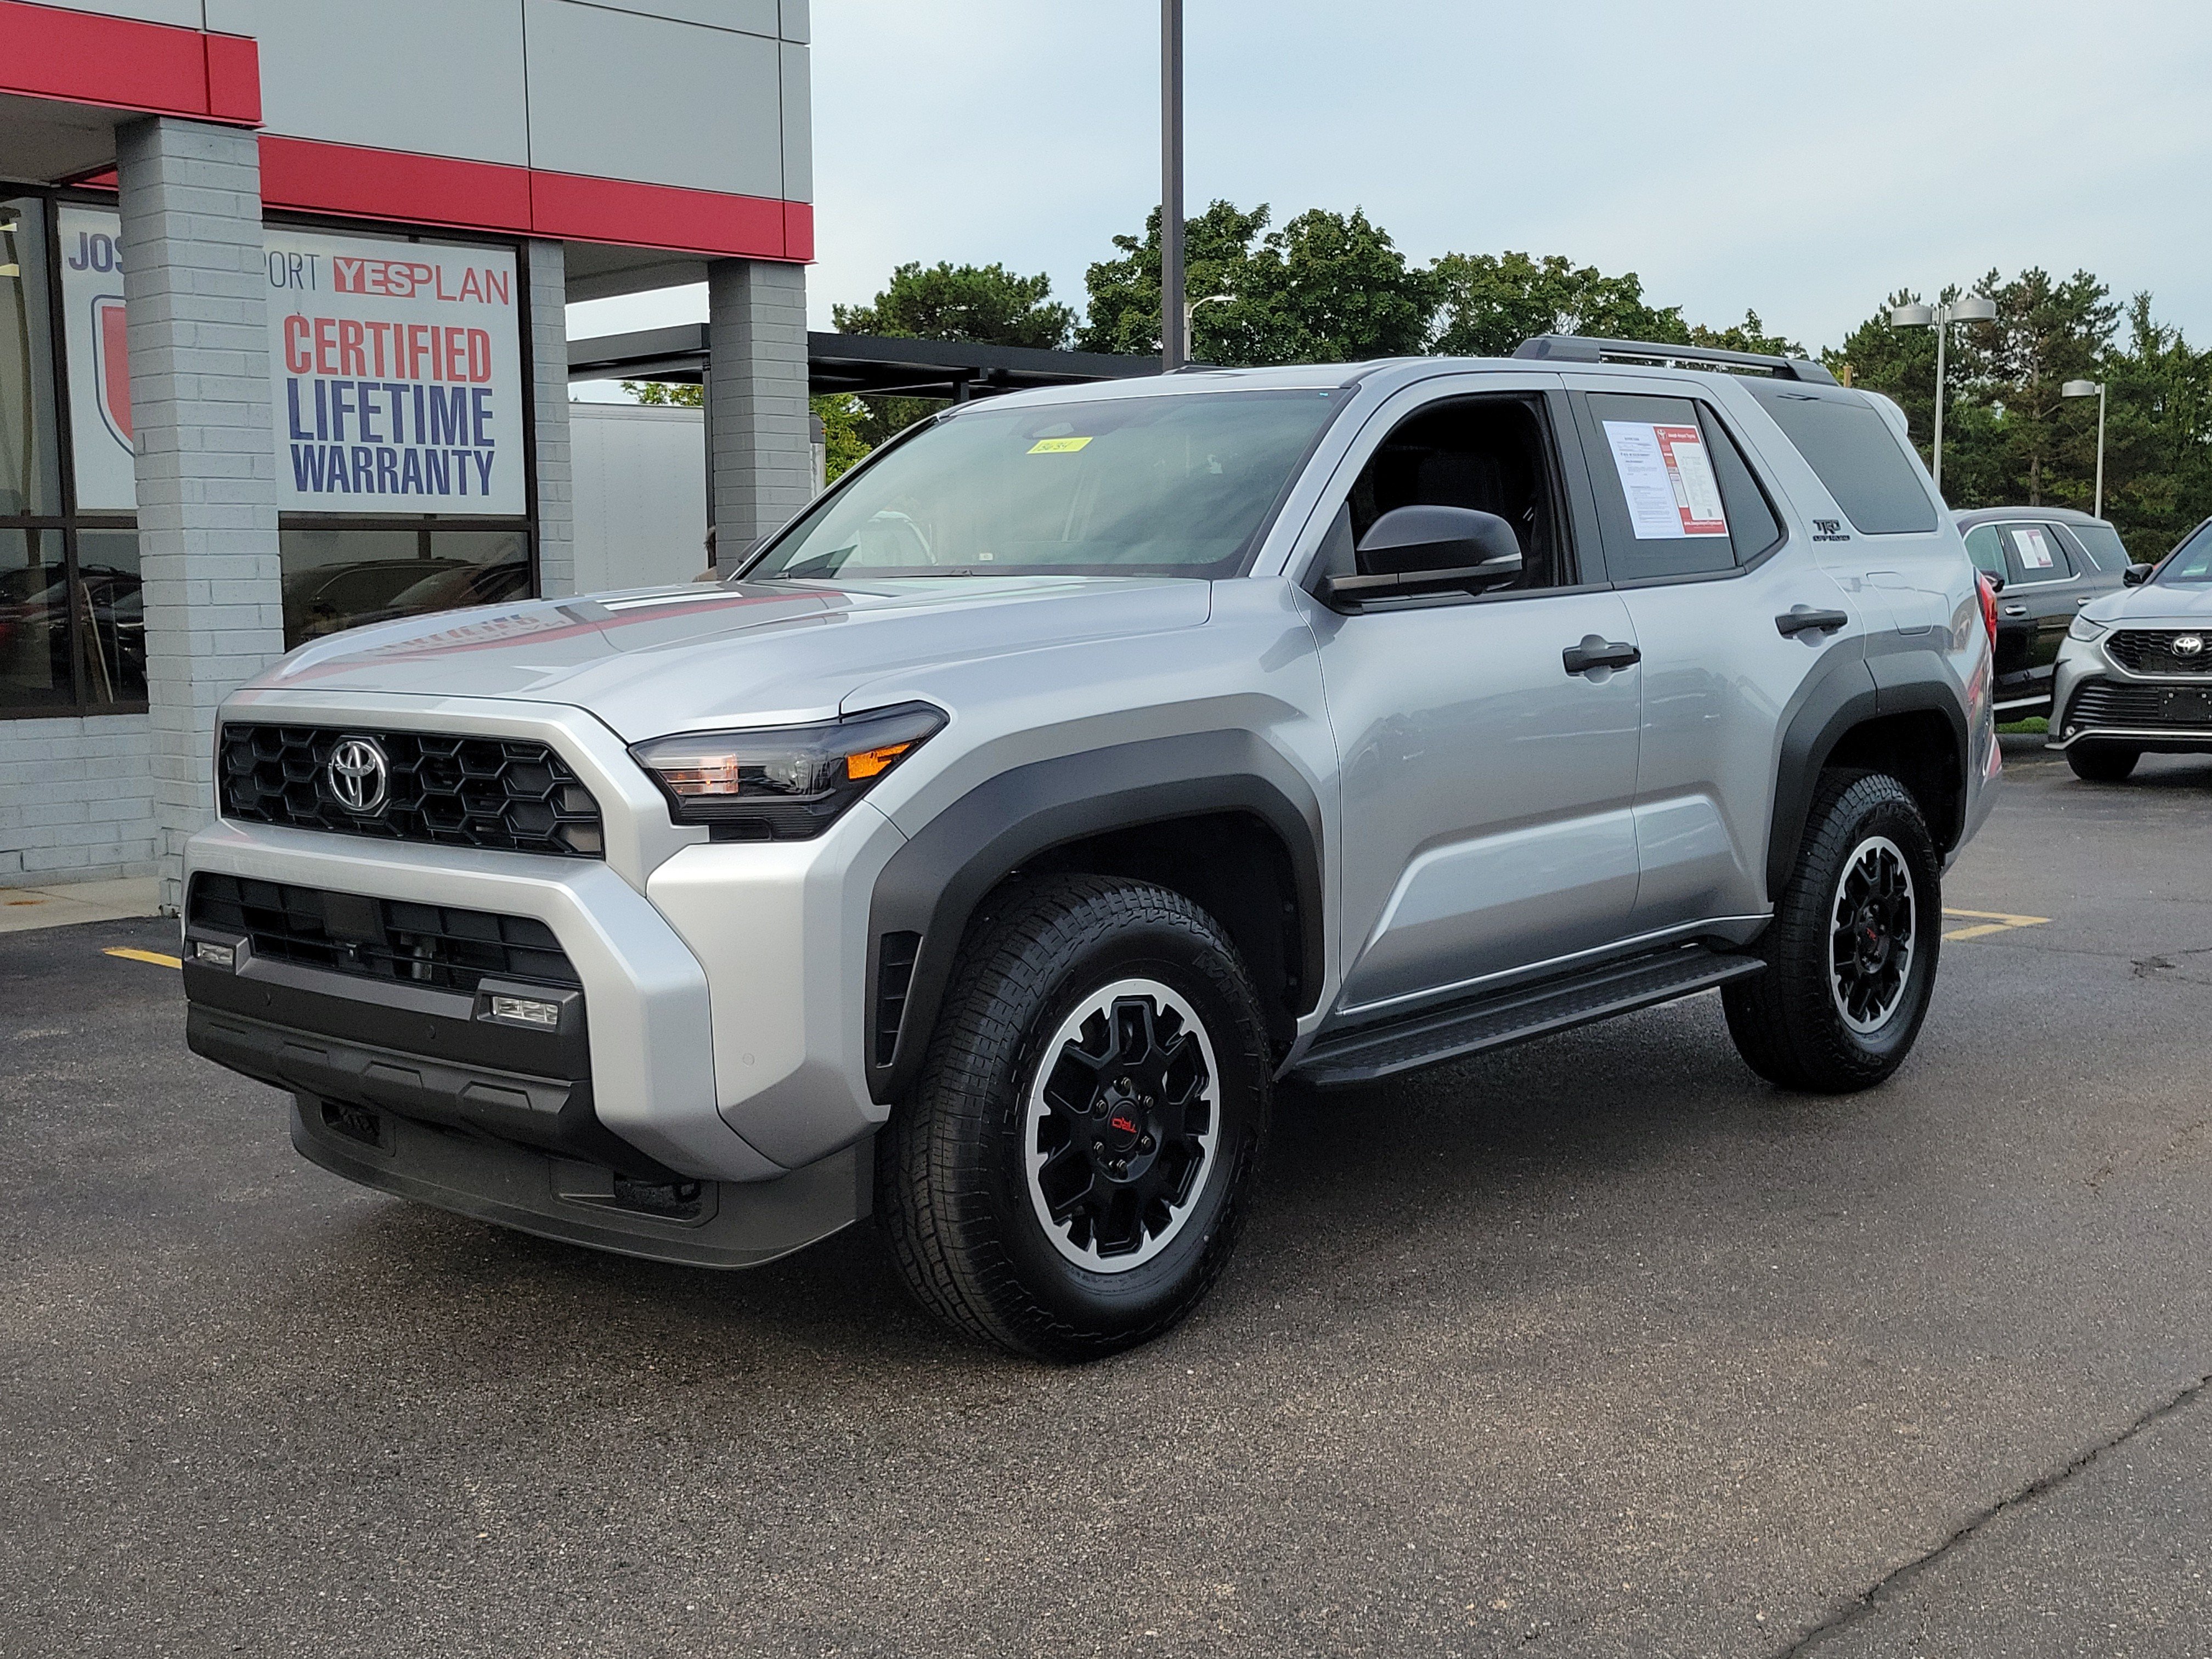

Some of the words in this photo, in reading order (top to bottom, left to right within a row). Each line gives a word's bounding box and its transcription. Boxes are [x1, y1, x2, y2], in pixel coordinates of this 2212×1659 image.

[264, 251, 320, 290] ORT
[284, 314, 491, 383] CERTIFIED
[287, 377, 495, 447] LIFETIME
[290, 444, 495, 496] WARRANTY
[1812, 519, 1841, 535] TRD
